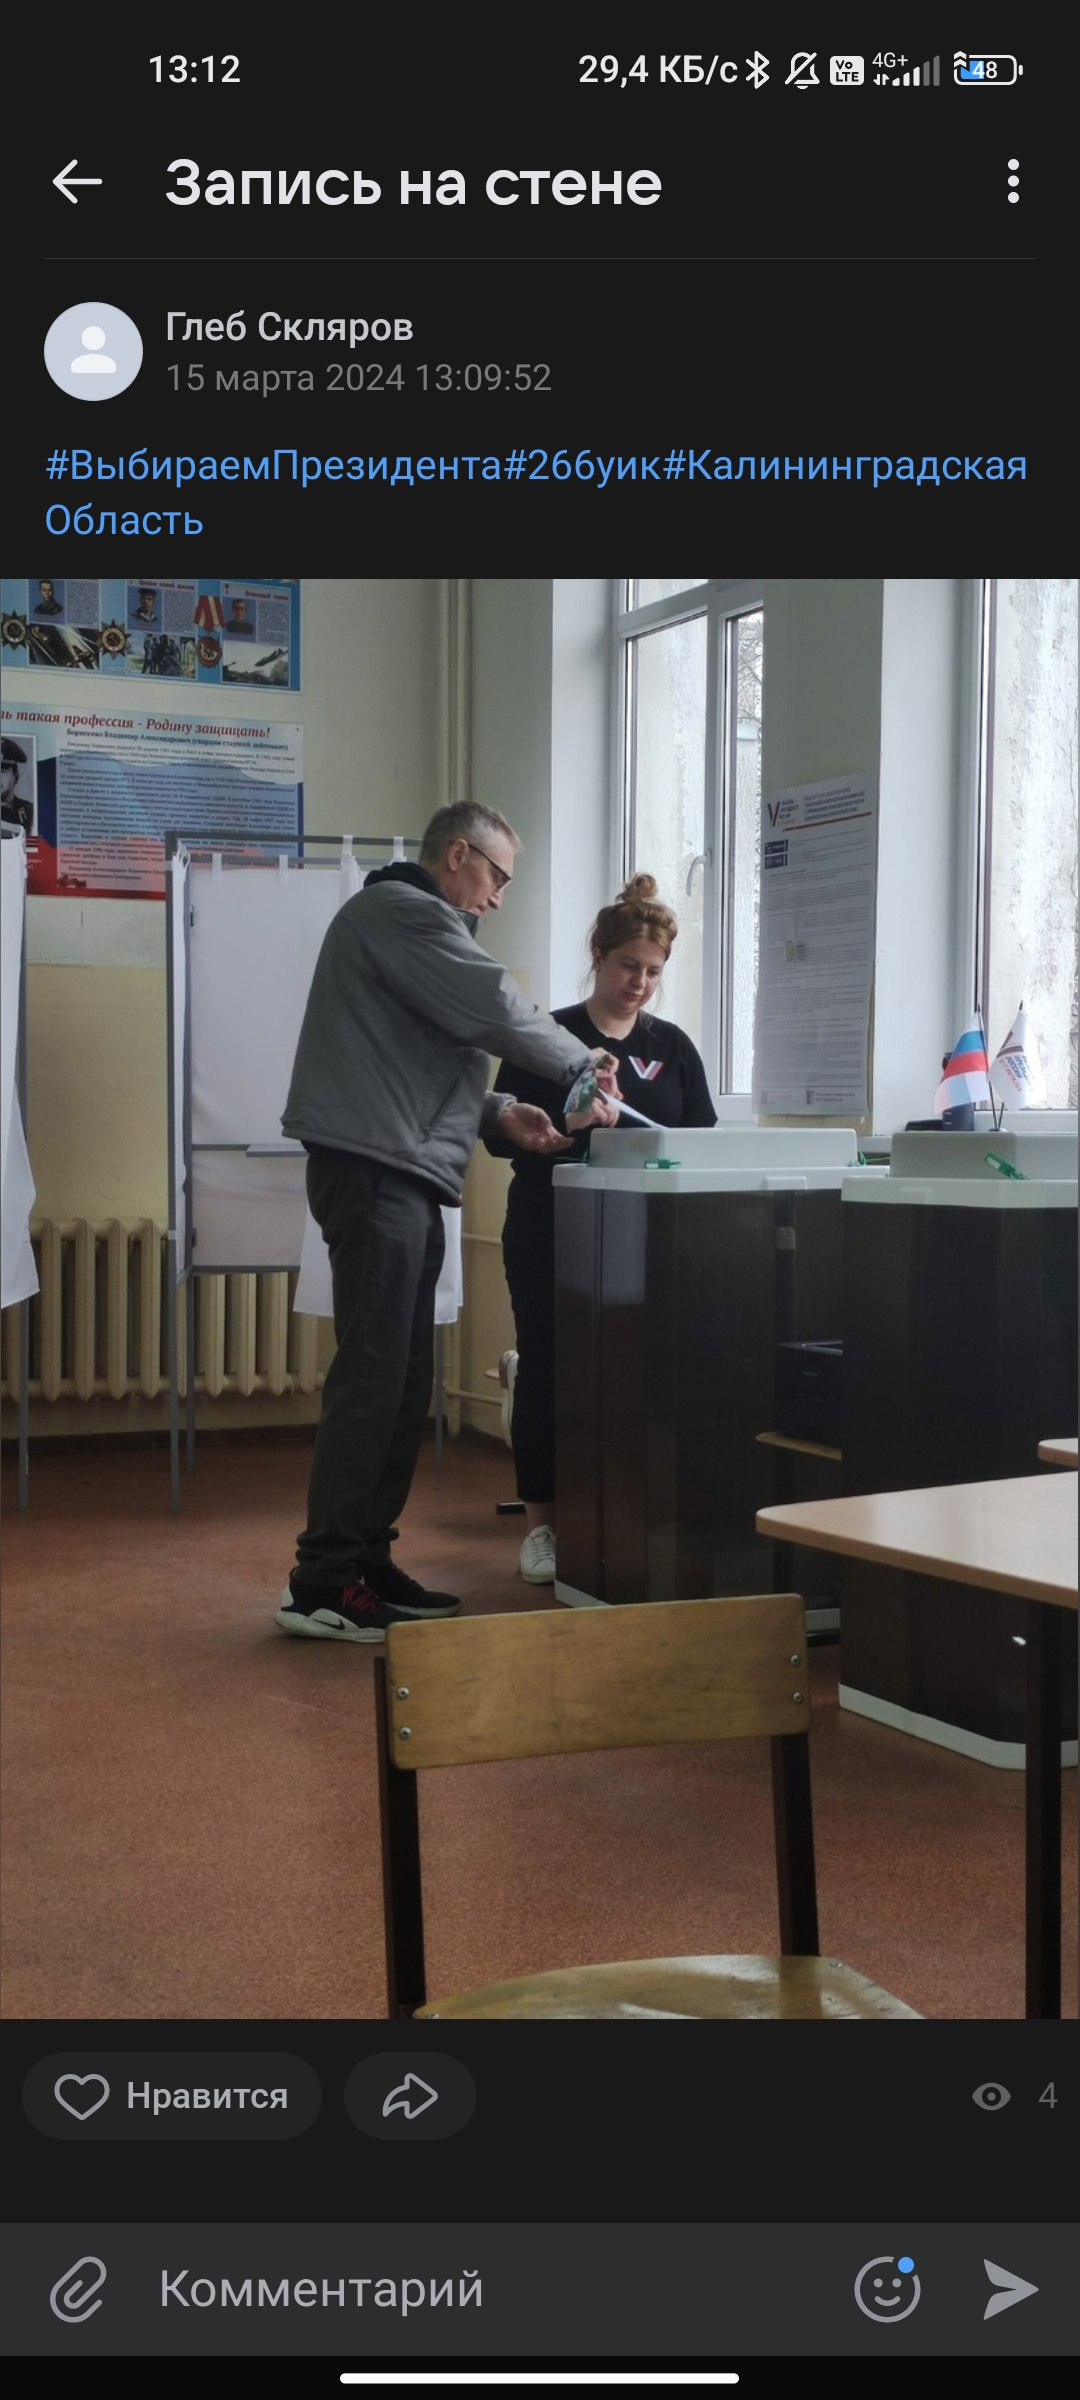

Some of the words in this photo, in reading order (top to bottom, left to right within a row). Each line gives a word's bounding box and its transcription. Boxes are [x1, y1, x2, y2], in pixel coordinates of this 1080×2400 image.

[149, 54, 241, 84] 13:12
[578, 54, 650, 89] 29,4
[659, 54, 739, 86] КБ/с
[835, 59, 853, 70] Vo
[871, 52, 909, 68] 4G+
[972, 60, 998, 79] 48
[835, 71, 859, 82] LTE
[166, 158, 382, 206] Запись
[400, 169, 466, 206] на
[485, 169, 663, 206] стене
[167, 309, 247, 342] Глеб
[258, 311, 414, 349] Скляров
[167, 363, 205, 391] 15
[216, 370, 315, 398] марта
[326, 363, 406, 391] 2024
[416, 363, 552, 391] 13:09:52
[45, 501, 204, 536] Область
[16, 711, 60, 723] такая
[64, 714, 133, 728] профессия
[146, 719, 192, 735] Родину
[195, 724, 271, 738] защищать!
[104, 731, 138, 741] Владимир
[127, 2081, 288, 2116] Нравится
[1038, 2082, 1058, 2109] 4
[161, 2269, 482, 2317] Комментарий
